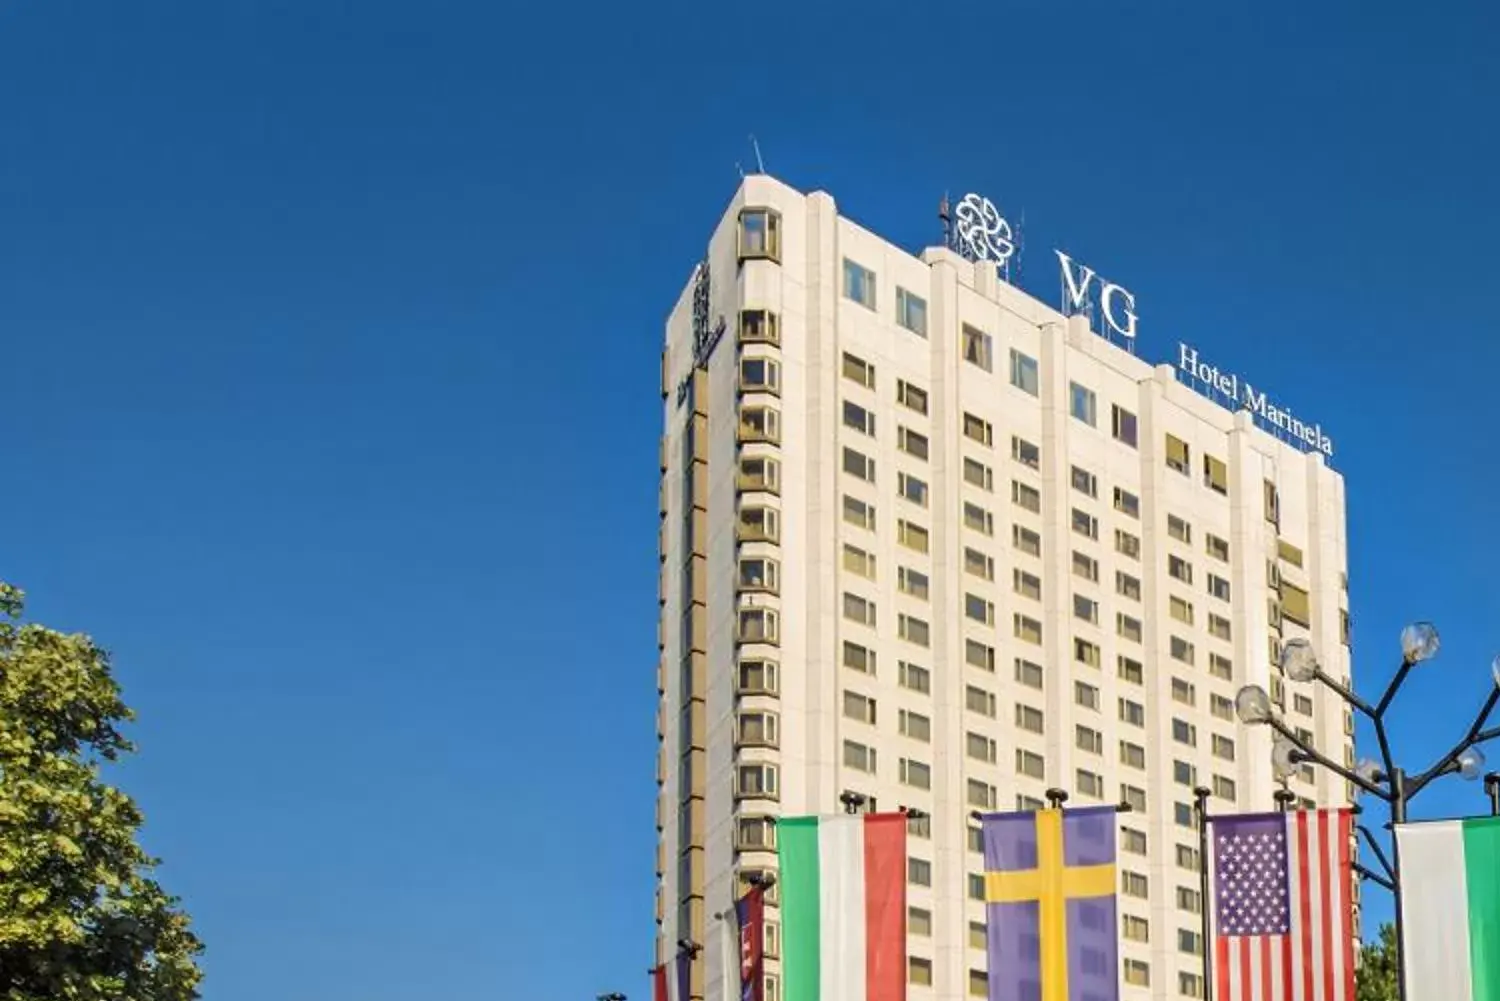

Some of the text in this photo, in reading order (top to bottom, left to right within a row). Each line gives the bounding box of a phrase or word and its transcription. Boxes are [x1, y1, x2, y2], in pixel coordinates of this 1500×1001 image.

[1054, 248, 1139, 338] VG
[1179, 341, 1334, 456] Hotel Marinela
